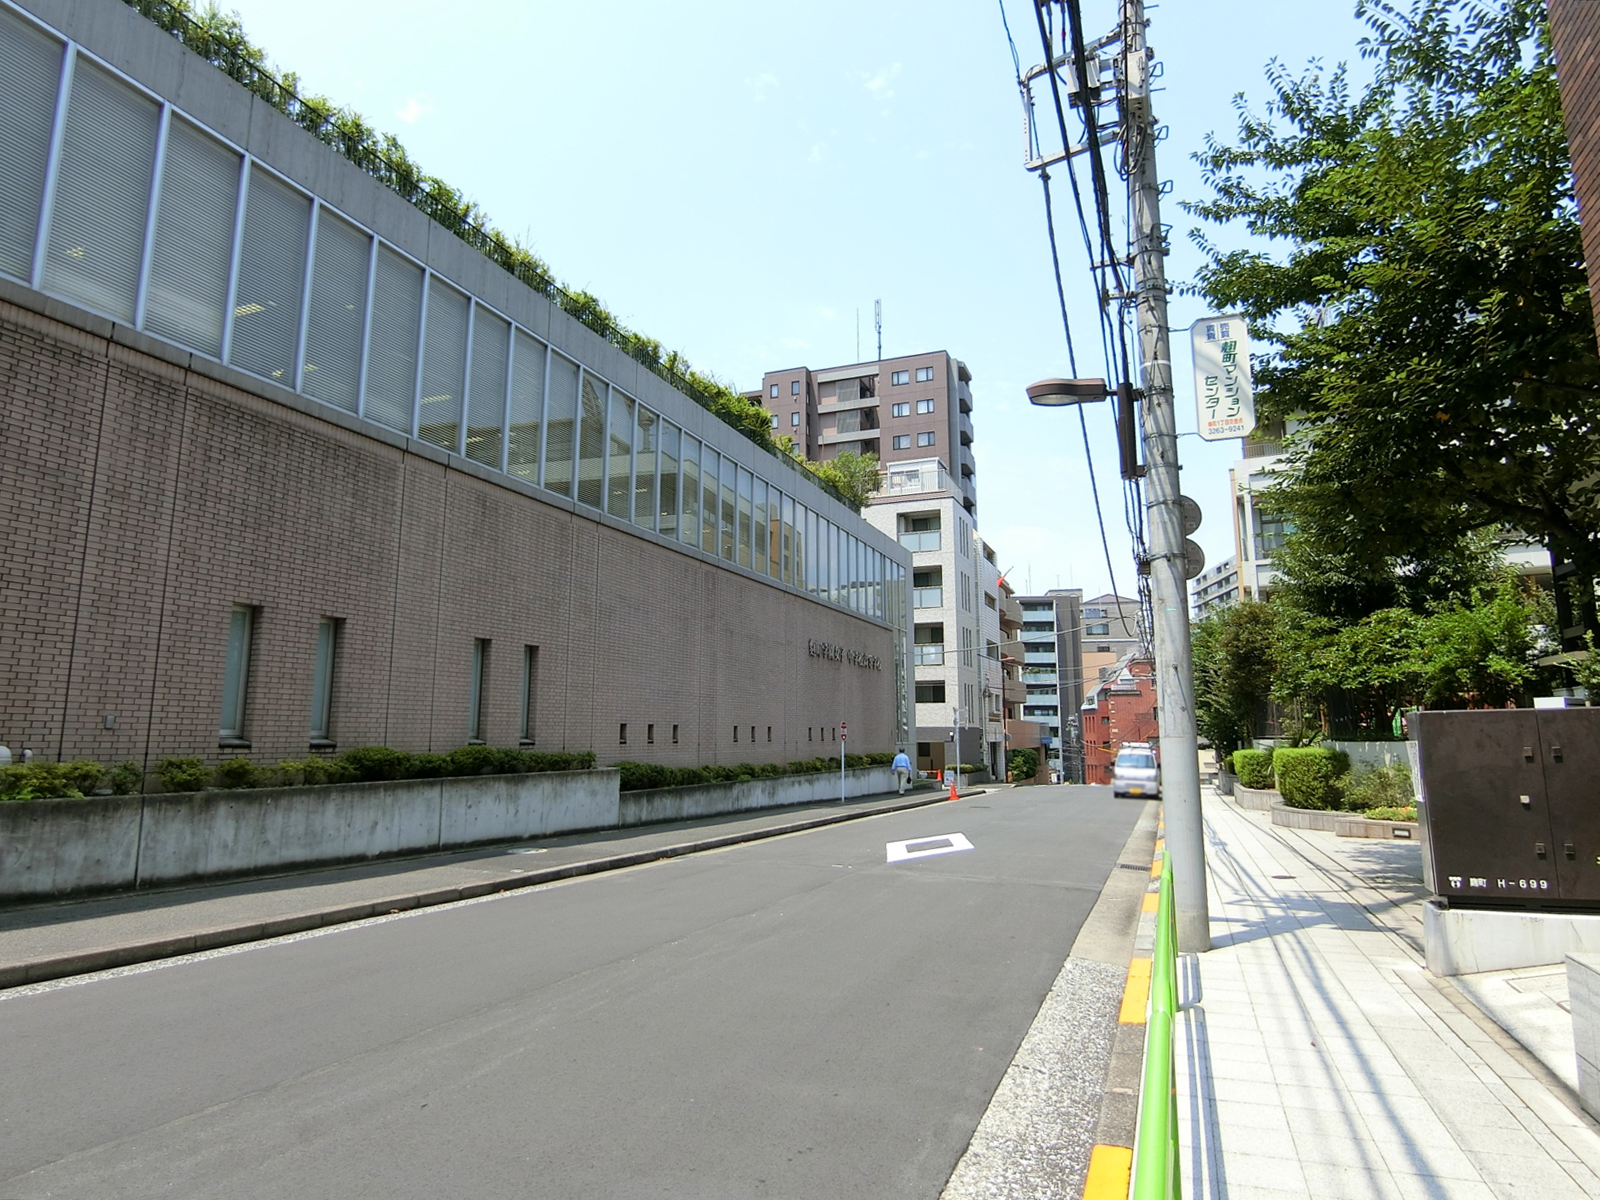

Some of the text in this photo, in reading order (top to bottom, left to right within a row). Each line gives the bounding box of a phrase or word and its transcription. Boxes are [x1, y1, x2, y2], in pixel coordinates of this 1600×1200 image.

[1204, 375, 1220, 419] センター
[1208, 425, 1245, 435] 3263-9241
[1497, 878, 1547, 889] H-699
